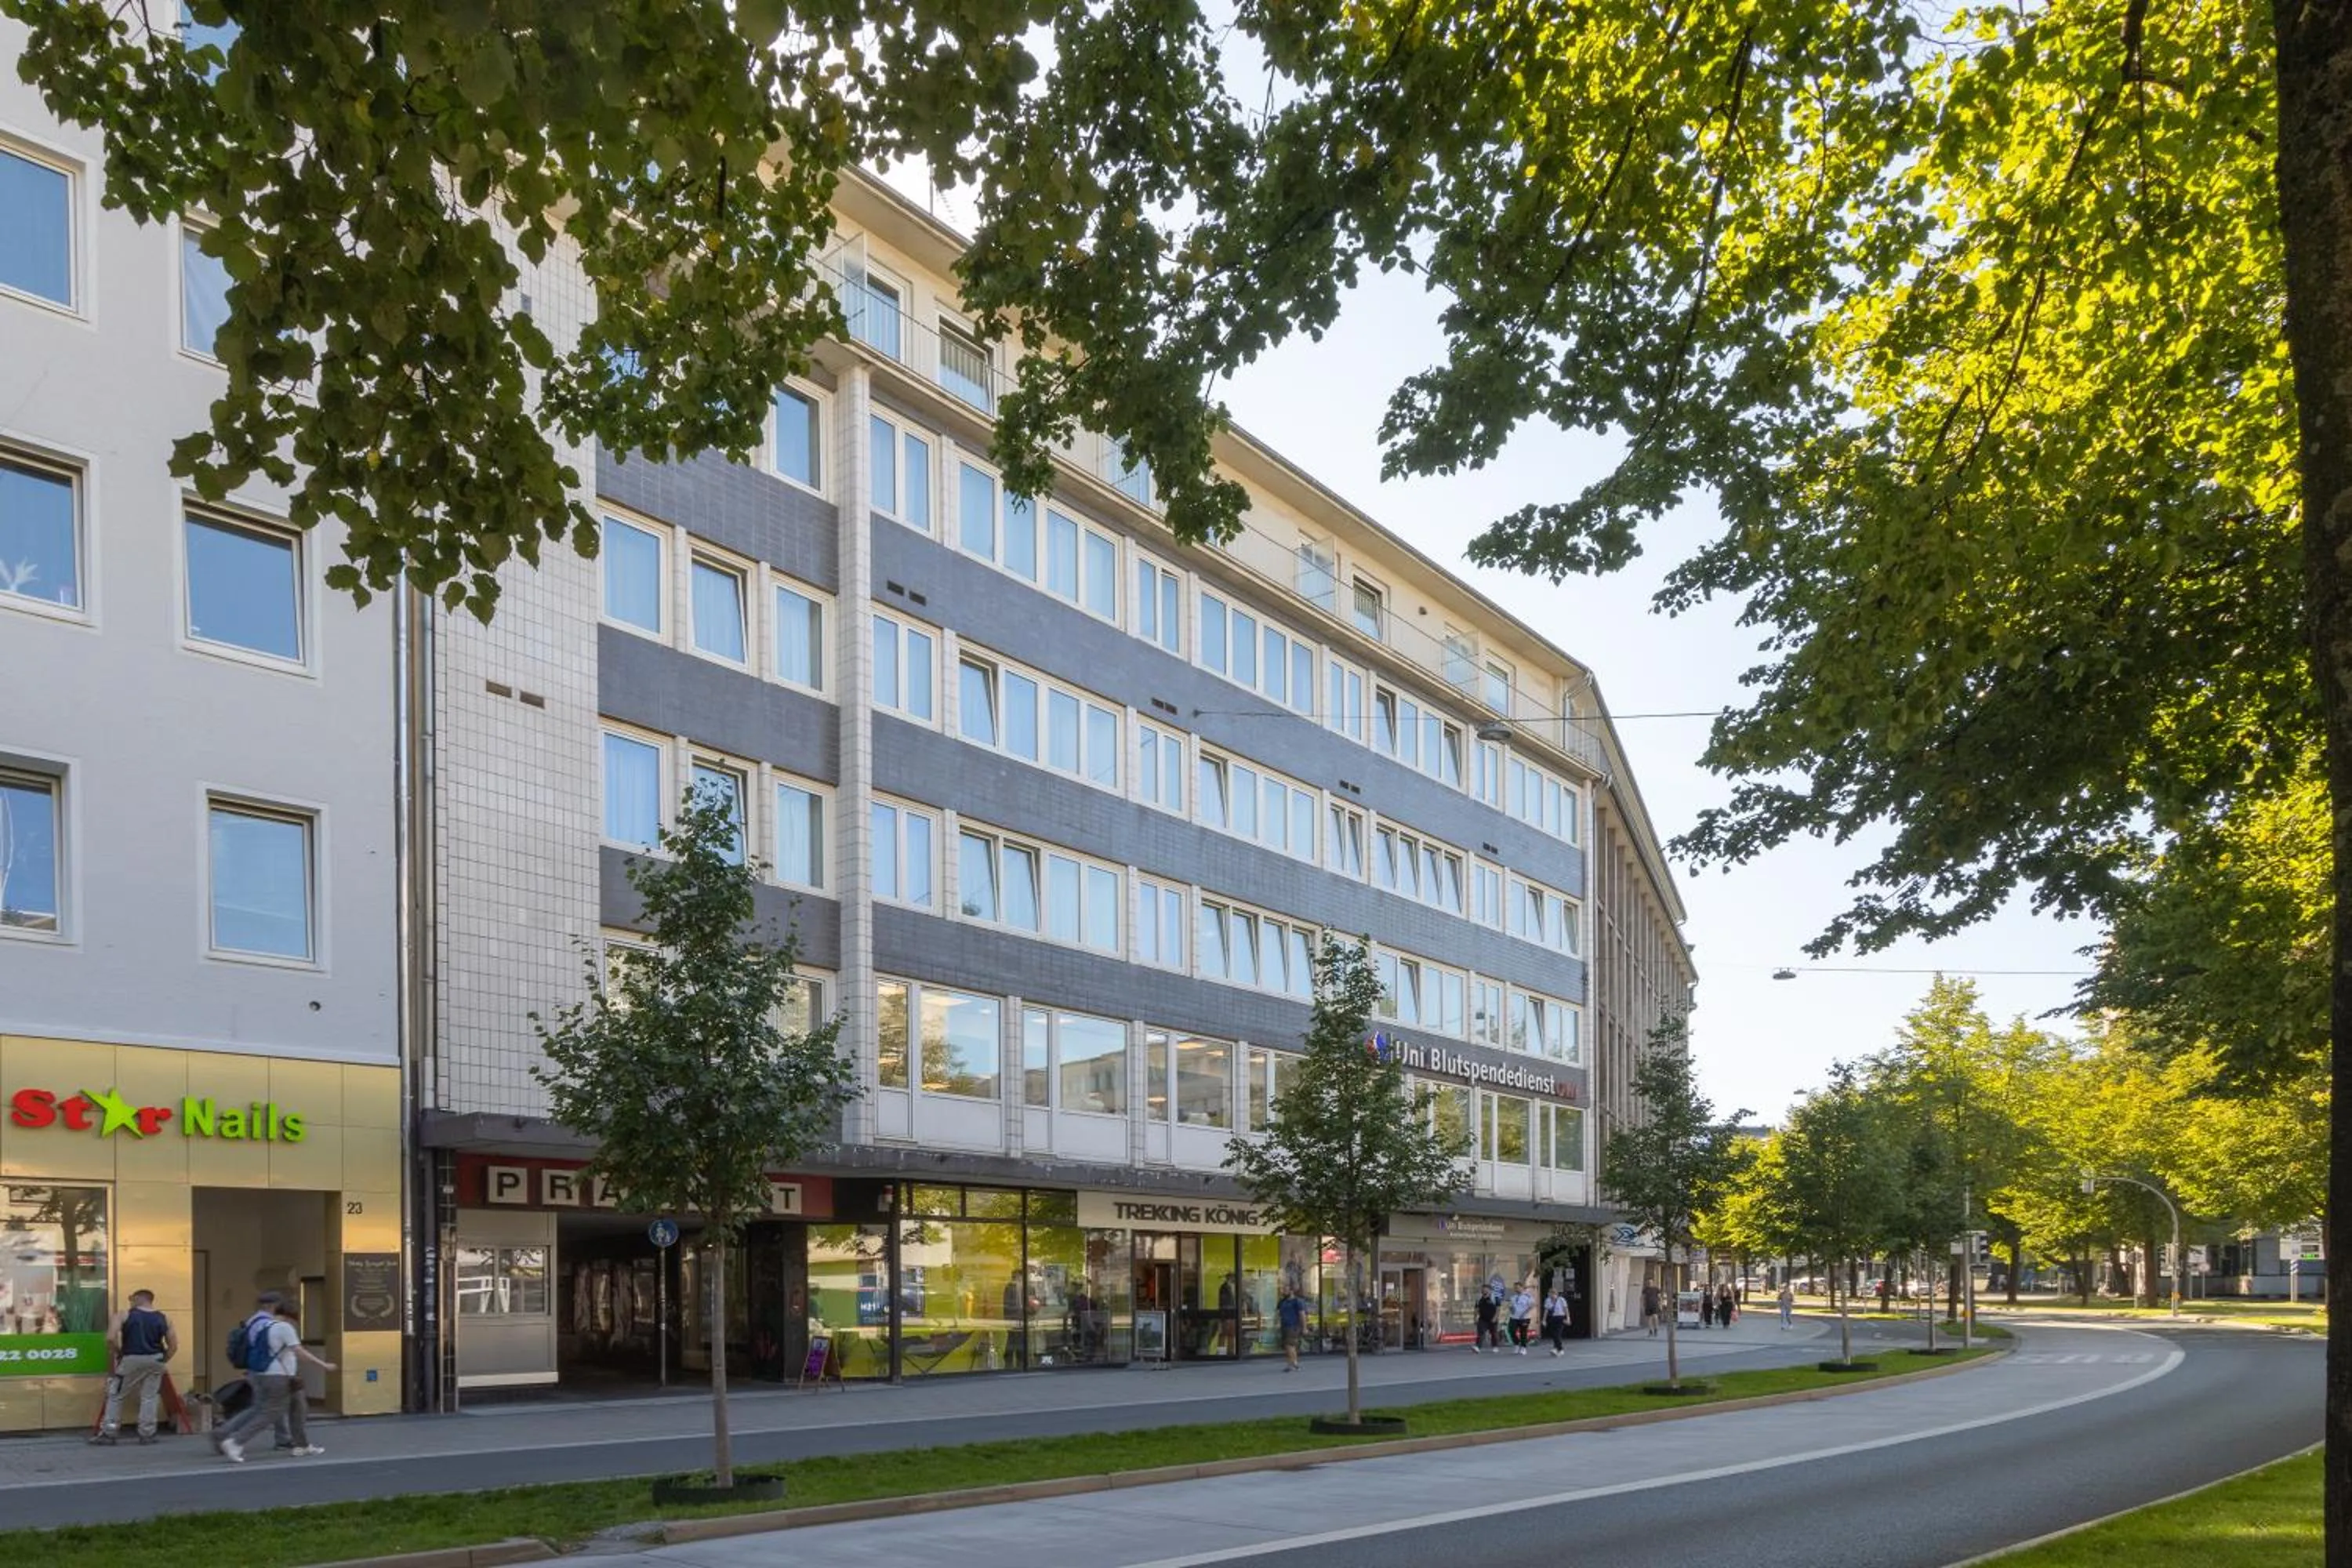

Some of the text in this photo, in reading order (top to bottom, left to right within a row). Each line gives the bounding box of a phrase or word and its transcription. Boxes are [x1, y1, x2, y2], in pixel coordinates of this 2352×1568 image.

[1396, 1040, 1425, 1068] Uni
[1431, 1047, 1556, 1095] Blutspendedienst
[182, 1096, 307, 1143] Nails
[347, 1201, 363, 1214] 23
[1113, 1201, 1258, 1225] TREKKING KÖNIG
